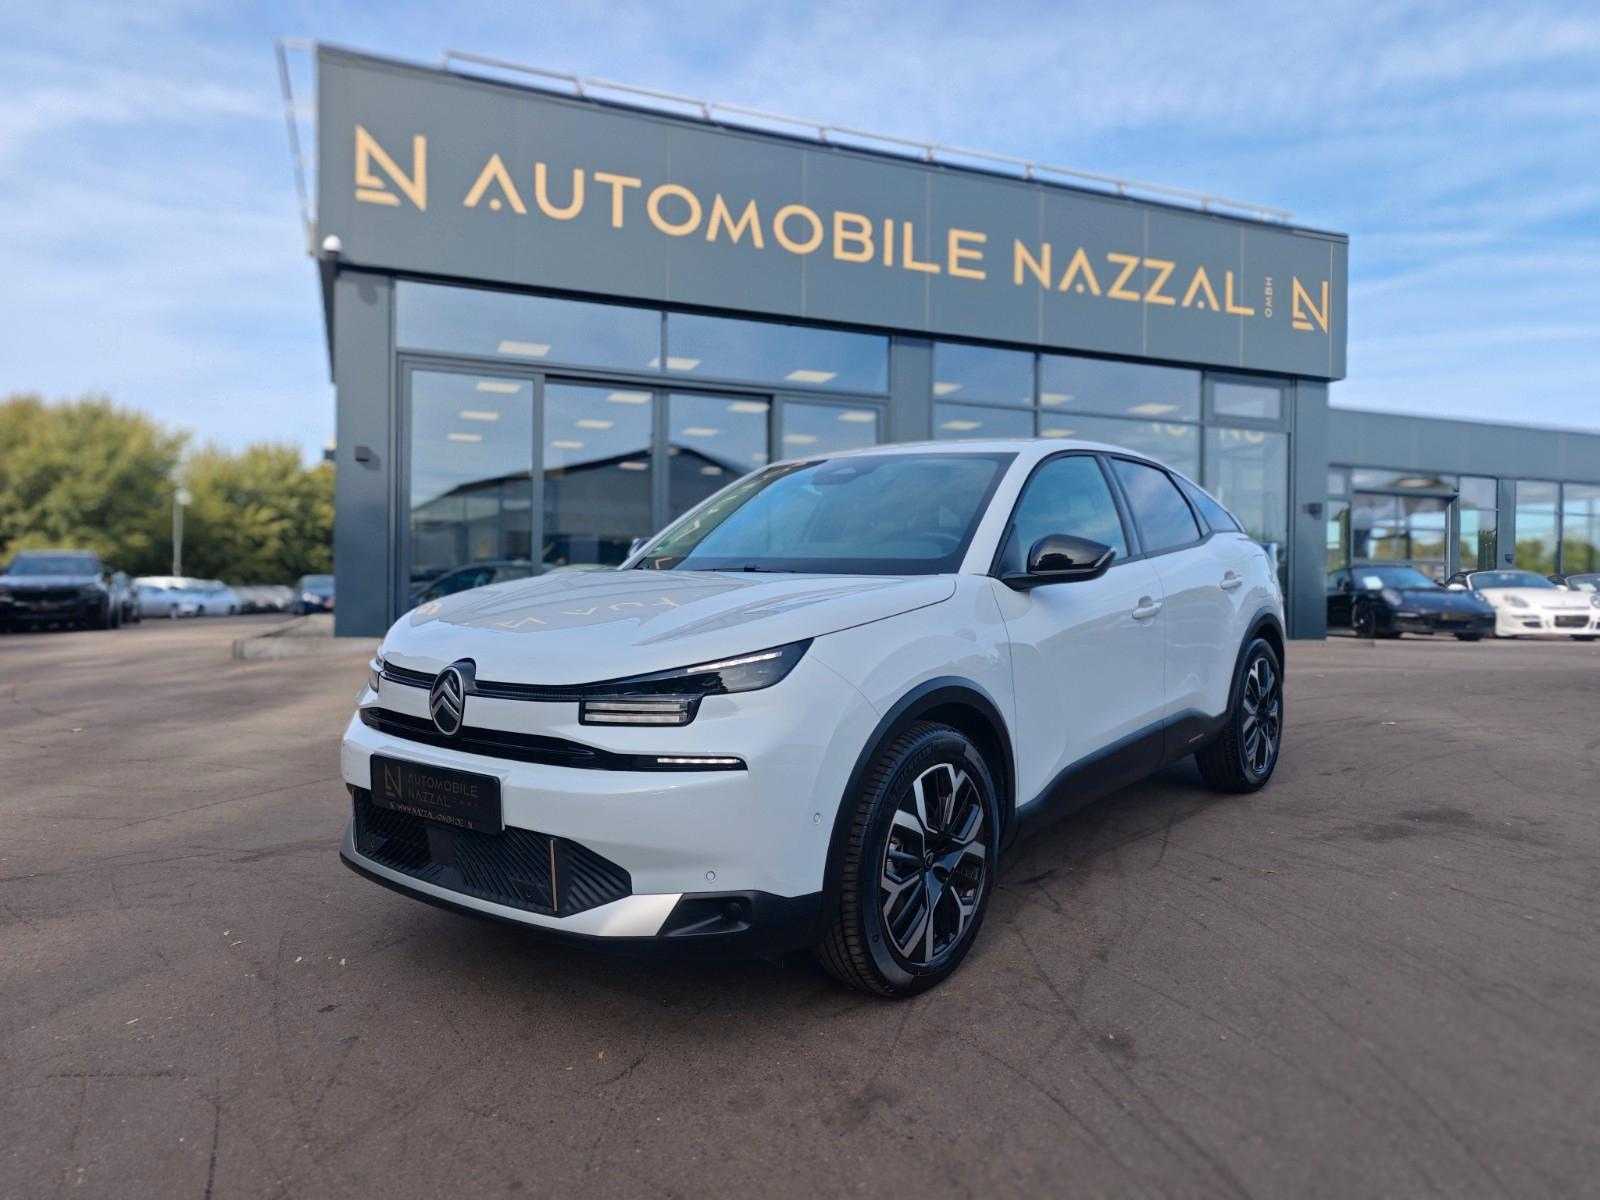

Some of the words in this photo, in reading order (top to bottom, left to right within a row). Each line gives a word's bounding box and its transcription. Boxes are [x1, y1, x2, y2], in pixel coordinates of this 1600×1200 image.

[463, 153, 988, 281] AUTOMOBILE
[1013, 238, 1255, 317] NAZZAL
[407, 773, 479, 798] AUTOMOBILE
[408, 788, 450, 808] NAZZAL
